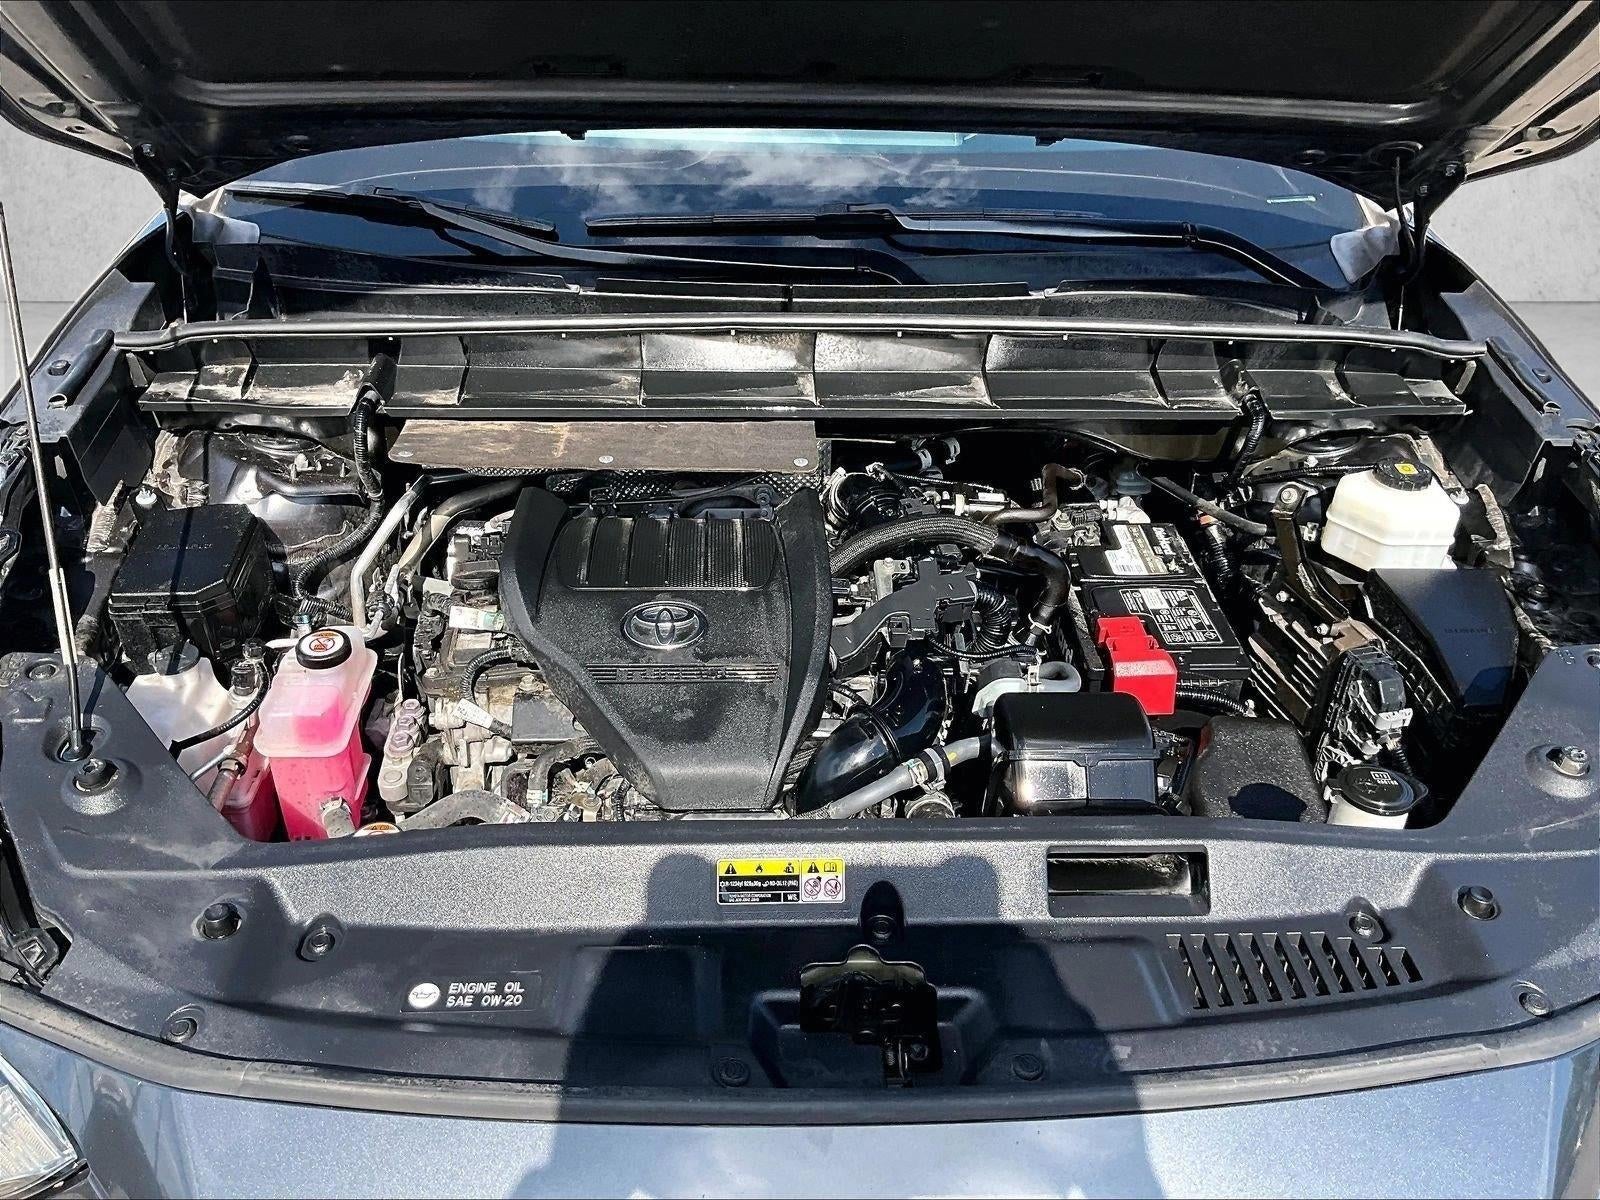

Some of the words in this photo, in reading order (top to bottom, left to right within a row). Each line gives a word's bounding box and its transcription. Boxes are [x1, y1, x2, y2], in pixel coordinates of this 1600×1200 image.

[448, 982, 497, 994] ENGINE
[504, 981, 525, 993] OIL
[446, 995, 474, 1008] SAE
[481, 994, 523, 1007] 0W-20
